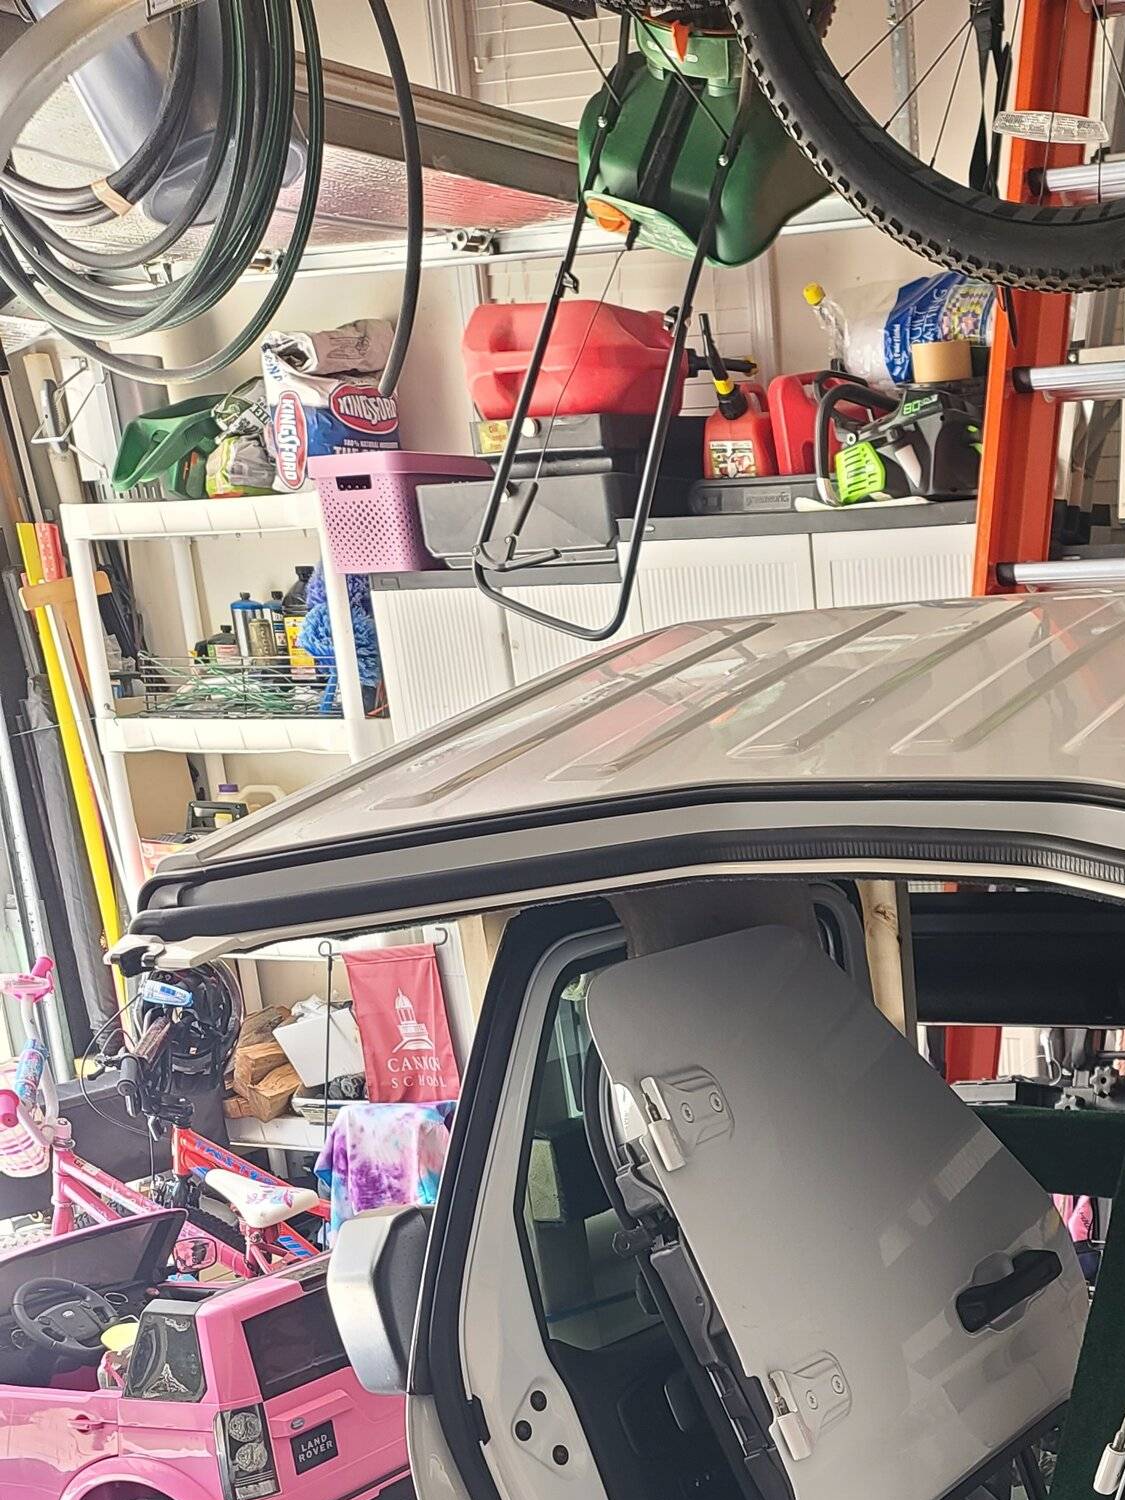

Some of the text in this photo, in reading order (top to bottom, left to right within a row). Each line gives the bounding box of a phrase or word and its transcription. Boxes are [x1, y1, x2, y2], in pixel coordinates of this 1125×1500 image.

[338, 395, 397, 425] KINGSFORD
[279, 398, 300, 480] KINGSFORD
[298, 1440, 333, 1463] ROVER
[301, 1434, 328, 1452] LAND
